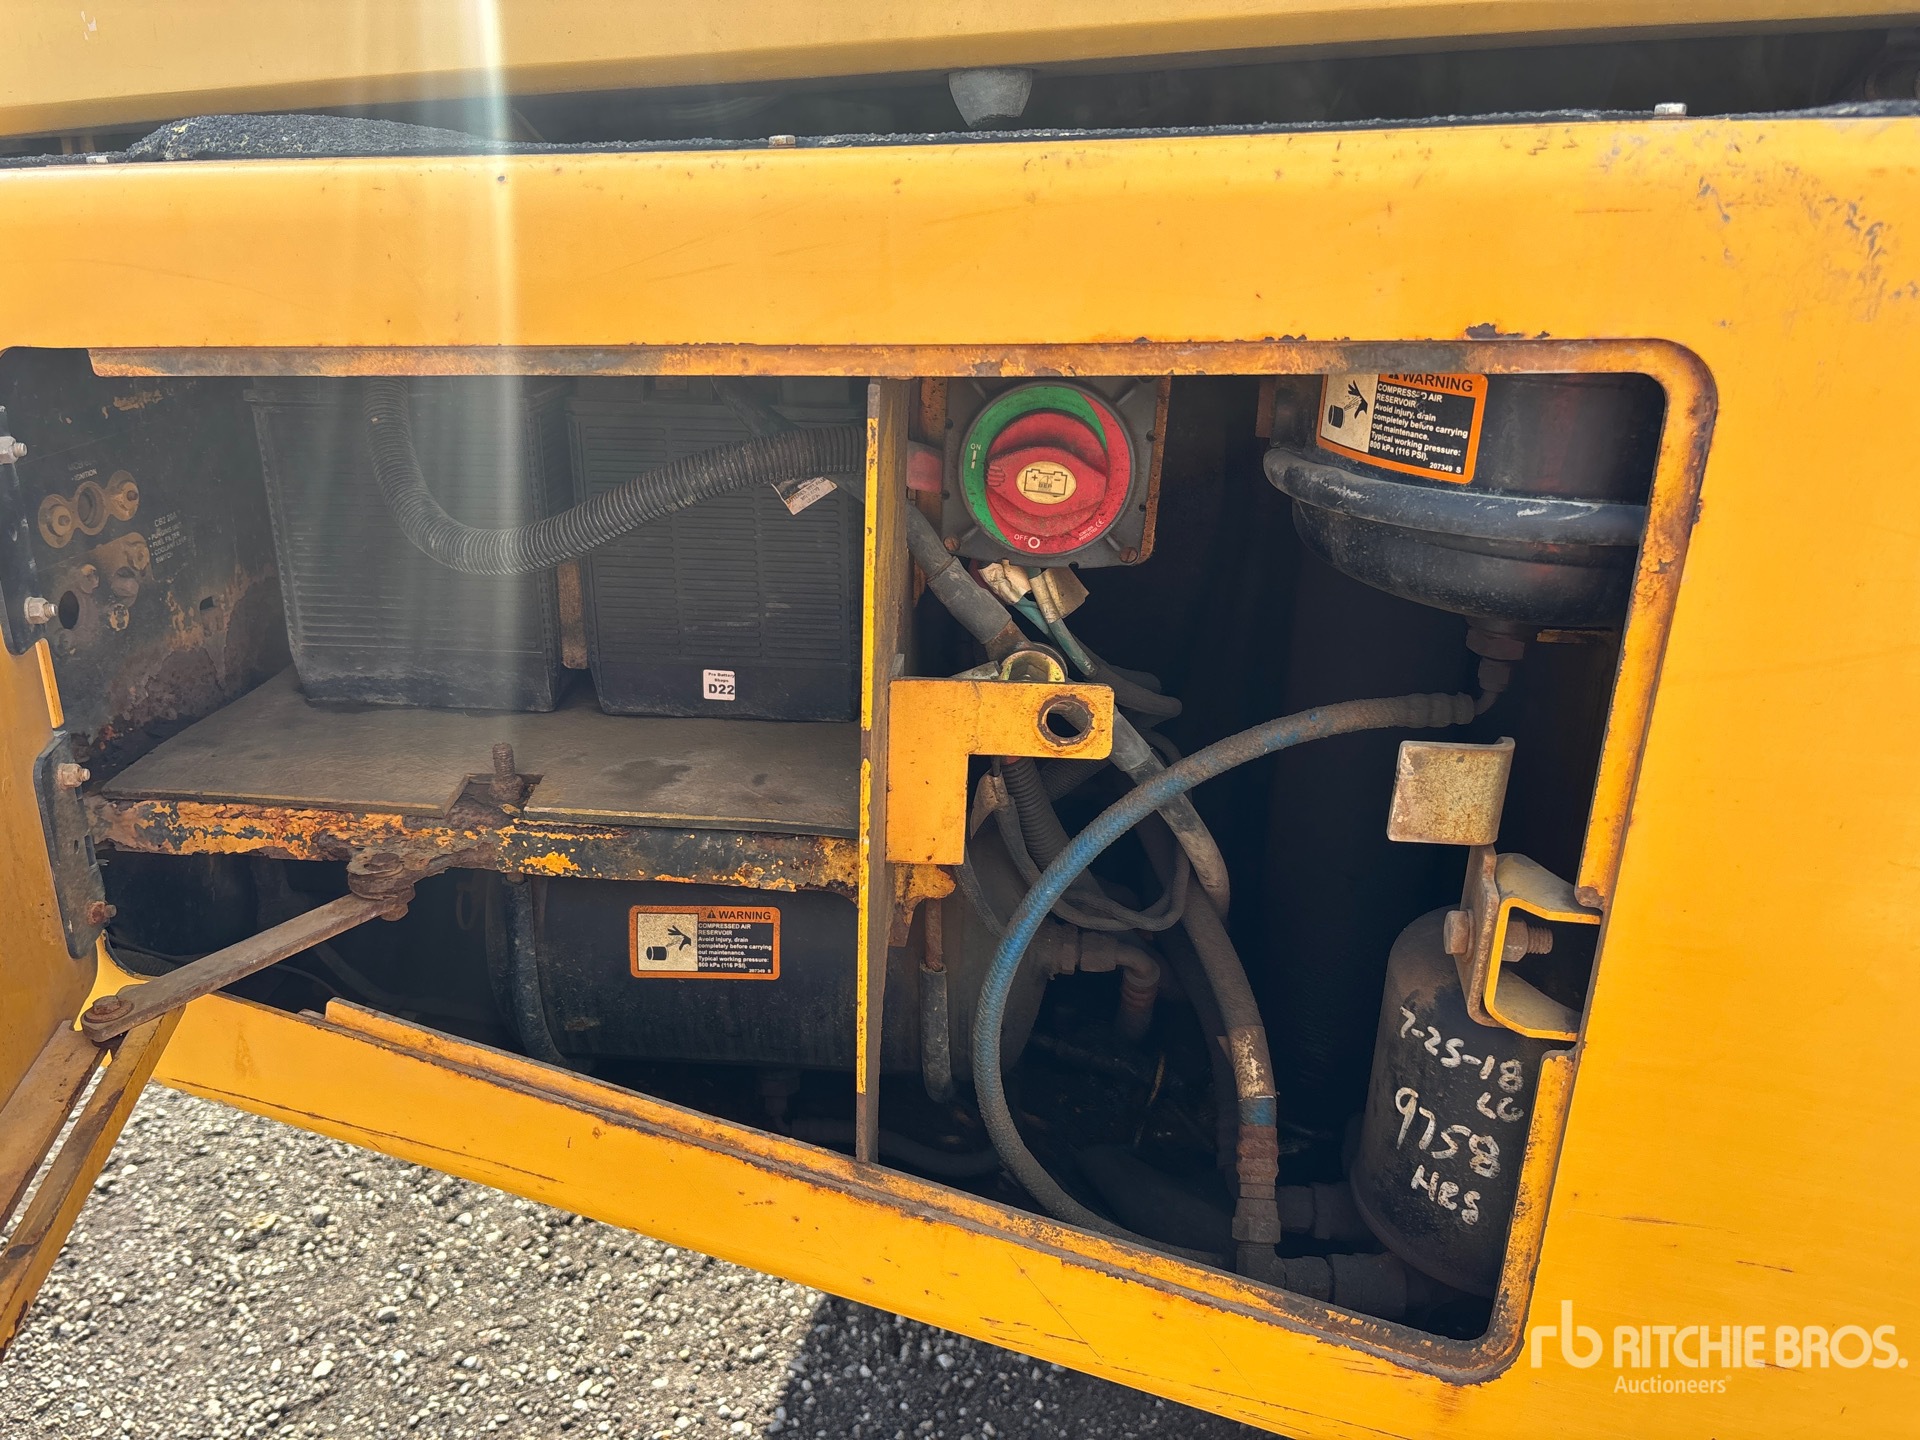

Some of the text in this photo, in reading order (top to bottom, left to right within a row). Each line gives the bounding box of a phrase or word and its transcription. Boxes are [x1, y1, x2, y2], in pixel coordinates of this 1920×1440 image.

[1403, 374, 1473, 392] WARNING
[1376, 393, 1417, 408] RESERVOIR
[1428, 392, 1443, 403] AIR
[1375, 403, 1436, 421] Avoid injury, drain
[1372, 423, 1429, 440] out maintenance.
[1373, 413, 1468, 439] completely before carrying
[1369, 440, 1381, 449] 800
[1382, 443, 1394, 453] kPa
[1395, 446, 1410, 456] (116
[1371, 431, 1461, 456] Typical working pressure:
[1014, 533, 1029, 541] OFF
[708, 683, 735, 695] D22
[719, 910, 771, 920] WARNING
[1400, 1005, 1524, 1094] 7-25-18
[1395, 1087, 1501, 1179] 9758
